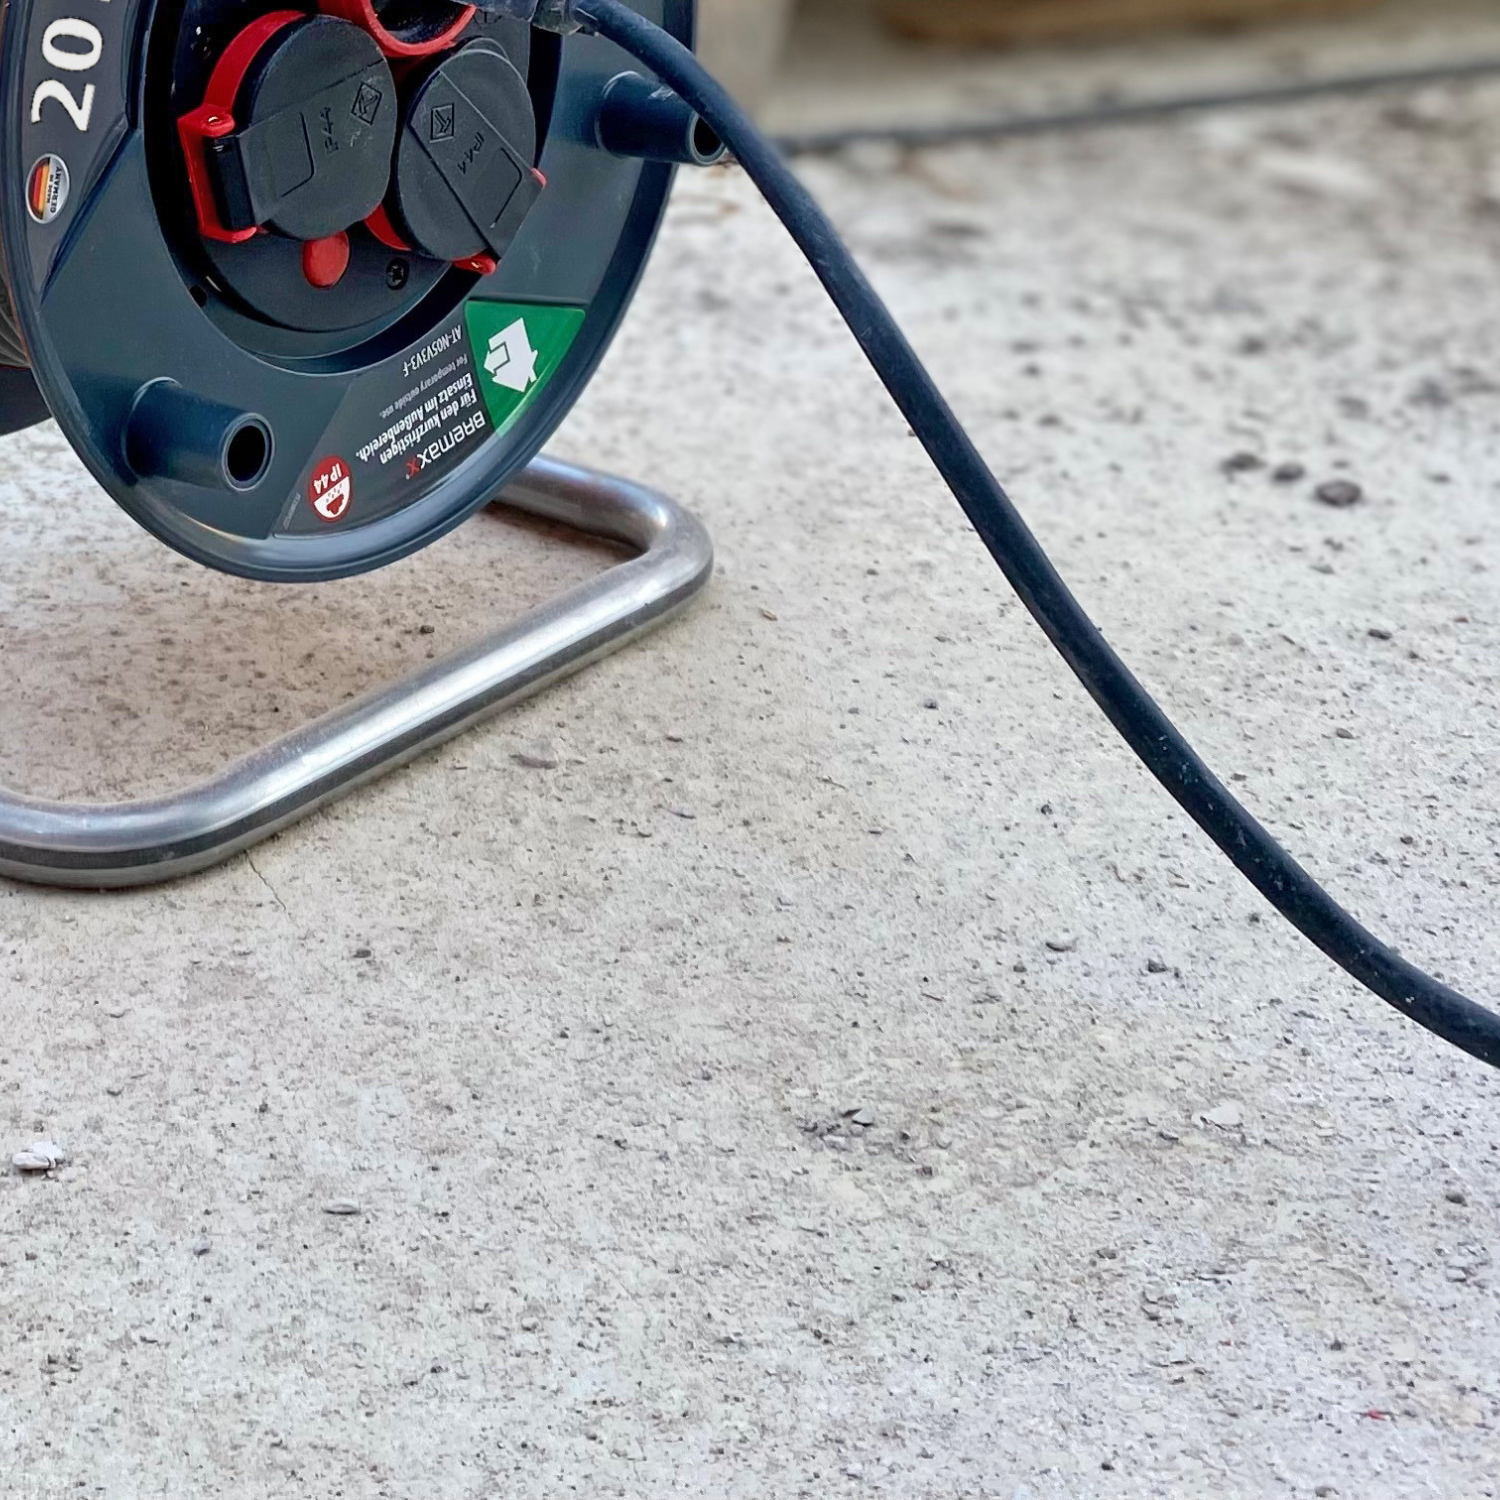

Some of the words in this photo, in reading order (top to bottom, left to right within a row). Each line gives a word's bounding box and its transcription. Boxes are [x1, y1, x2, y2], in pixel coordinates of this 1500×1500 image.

[30, 18, 103, 132] 20
[50, 166, 62, 213] GERMANY
[402, 324, 462, 378] AT-N05V3V3-F
[438, 372, 473, 404] Einsatz
[440, 399, 460, 422] den
[459, 387, 478, 409] Für
[355, 404, 425, 463] Außenbereich.
[379, 414, 441, 464] kurzfristigen
